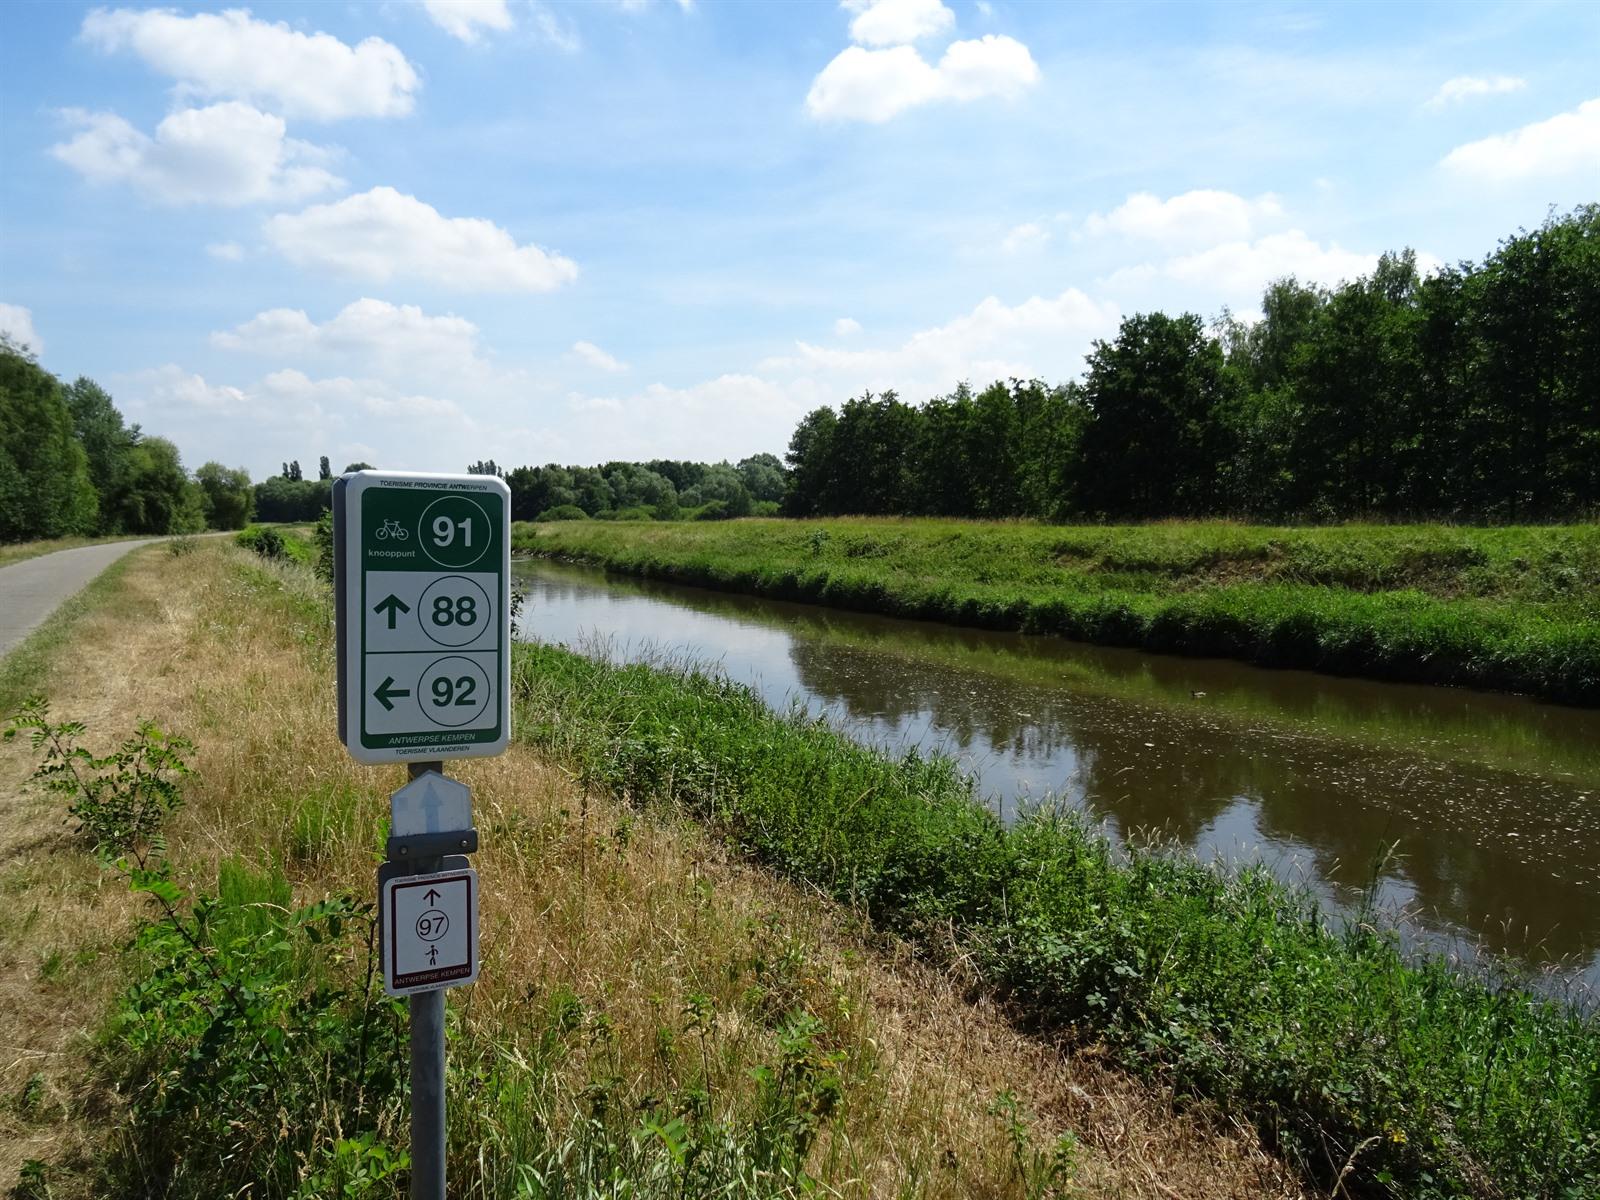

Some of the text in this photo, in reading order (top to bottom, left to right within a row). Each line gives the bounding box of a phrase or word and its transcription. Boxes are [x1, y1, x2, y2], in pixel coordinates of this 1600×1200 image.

[380, 480, 415, 488] TOERISME
[449, 483, 488, 491] ANTWERPEN
[432, 515, 472, 547] 91
[368, 549, 416, 558] knooppunt
[432, 595, 477, 627] 88
[431, 676, 477, 707] 92
[388, 733, 476, 744] ANTWERPSE KEMPEN
[429, 745, 471, 753] VLAANDEREN
[419, 916, 445, 936] 97
[394, 967, 471, 985] ANTWERPSE KEMPEN
